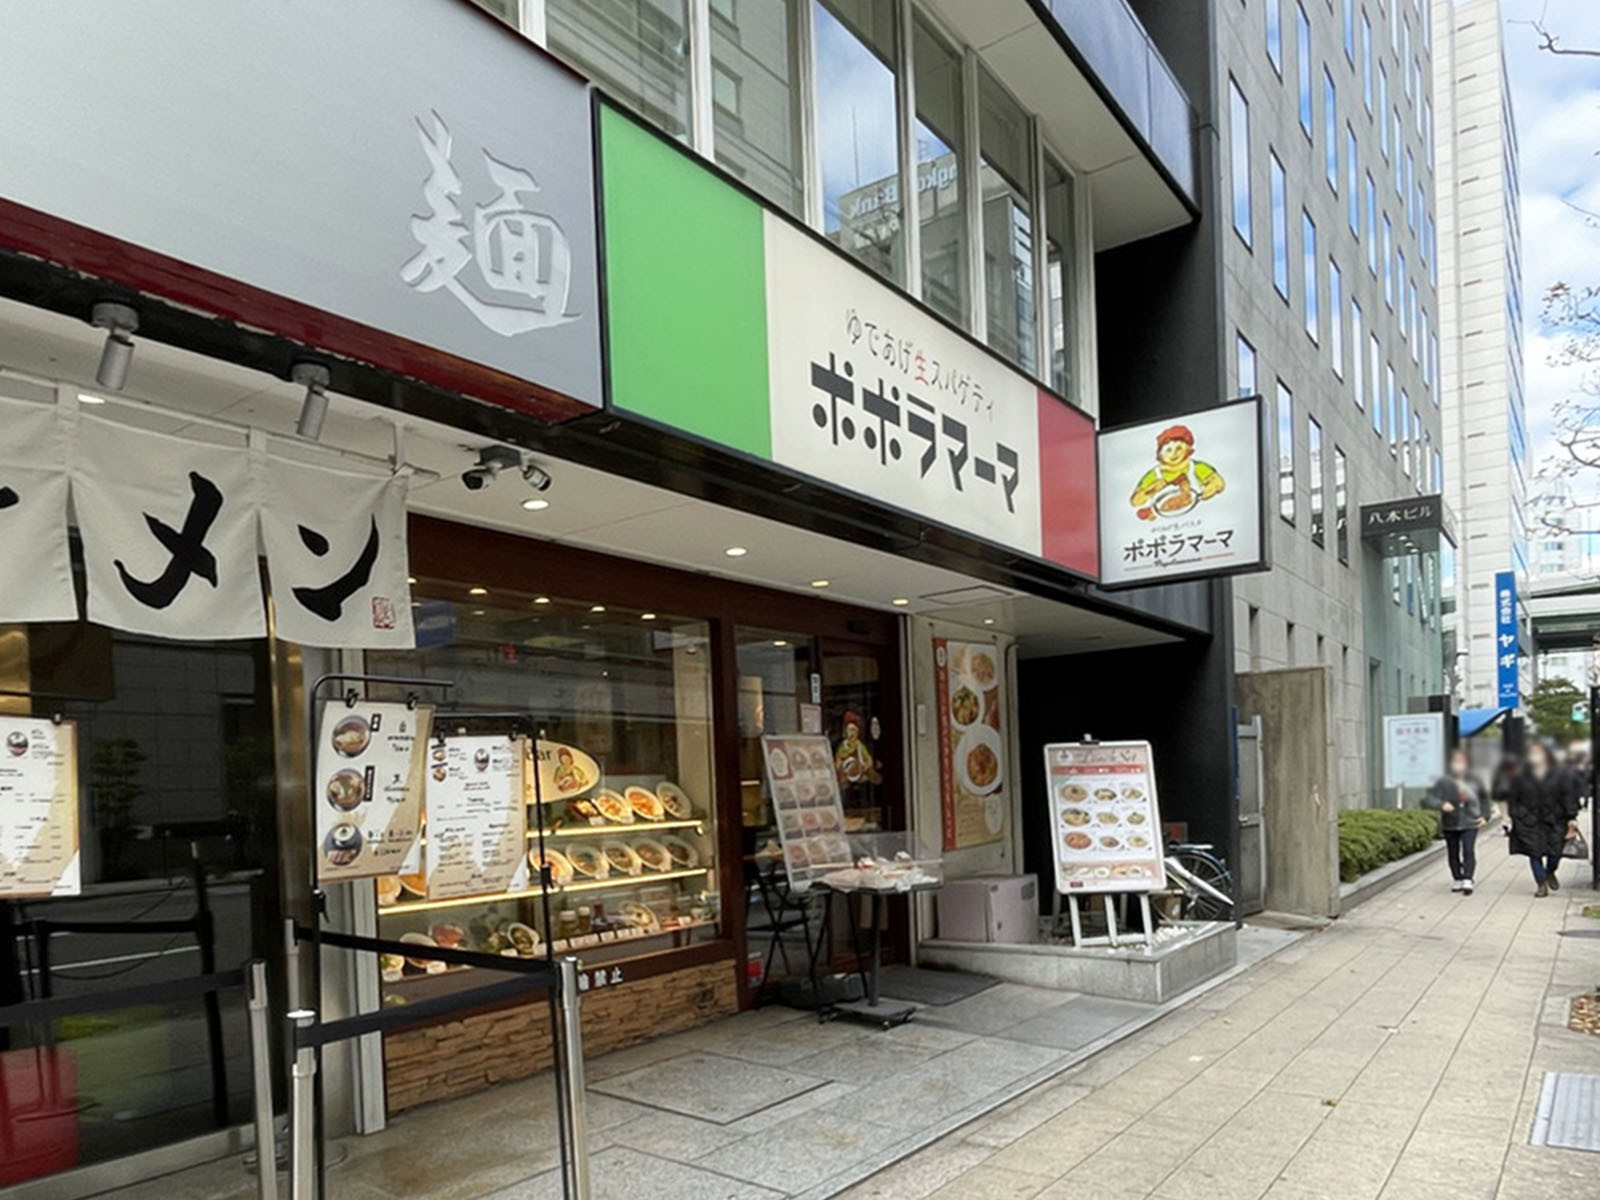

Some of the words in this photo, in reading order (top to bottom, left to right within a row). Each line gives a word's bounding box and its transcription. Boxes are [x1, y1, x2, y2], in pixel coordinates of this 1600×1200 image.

[847, 308, 994, 424] ゆであげ生スパゲティ
[811, 351, 1020, 514] ポポラマーマ
[0, 471, 379, 621] メン
[1123, 530, 1234, 562] ポポラマーマ
[1367, 506, 1433, 525] 八木ビル
[1499, 633, 1516, 670] ヤギ
